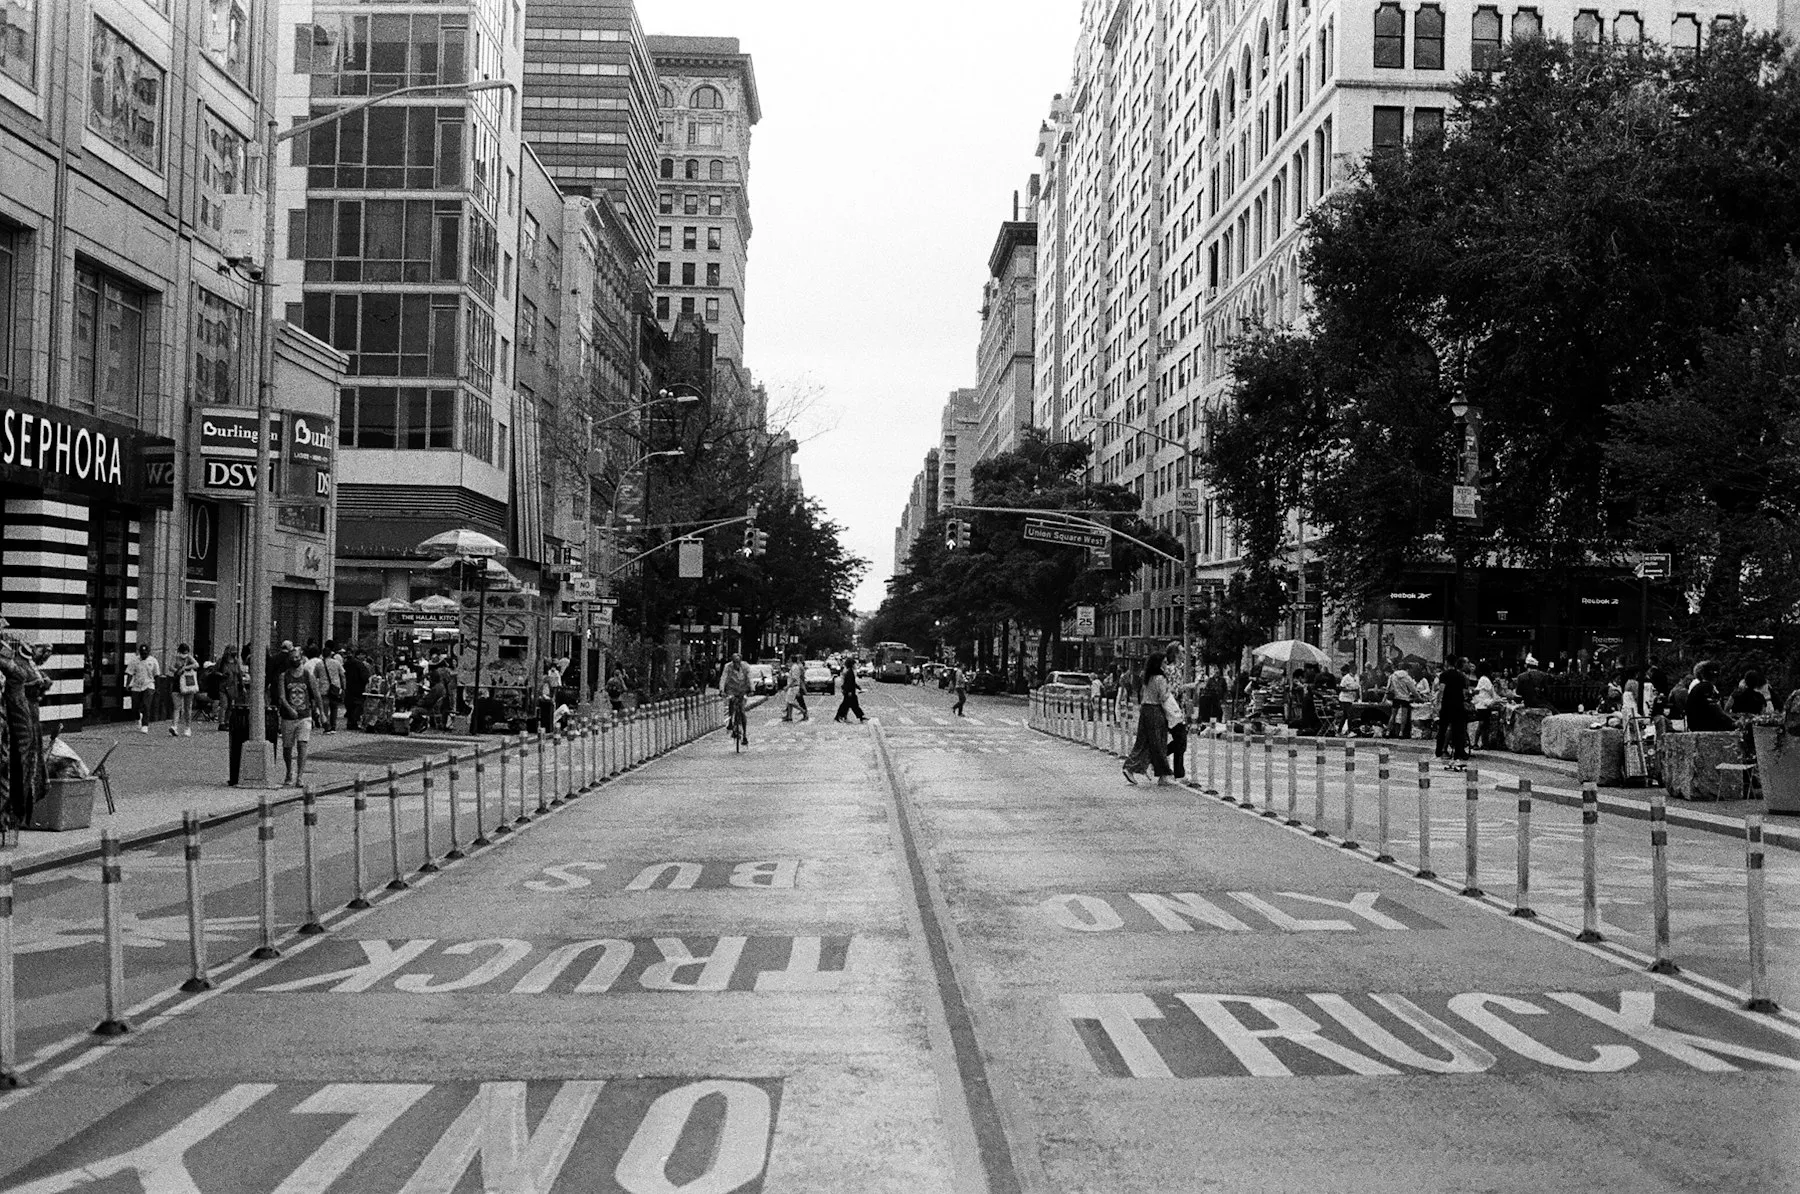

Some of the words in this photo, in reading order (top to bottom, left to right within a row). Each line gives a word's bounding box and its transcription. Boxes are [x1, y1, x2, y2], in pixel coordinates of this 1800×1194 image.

[203, 421, 278, 443] Burlingn
[3, 408, 122, 485] SEPHORA
[1027, 527, 1052, 539] Union
[1053, 530, 1081, 542] Square
[1083, 535, 1104, 546] West
[580, 581, 590, 589] NO
[1581, 597, 1610, 605] Reebok
[1079, 618, 1093, 626] 25
[1592, 635, 1623, 643] Reebok
[522, 861, 799, 892] BUS
[1040, 892, 1410, 932] ONLY
[258, 937, 858, 994] TRUCK
[1058, 990, 1800, 1077] TRUCK
